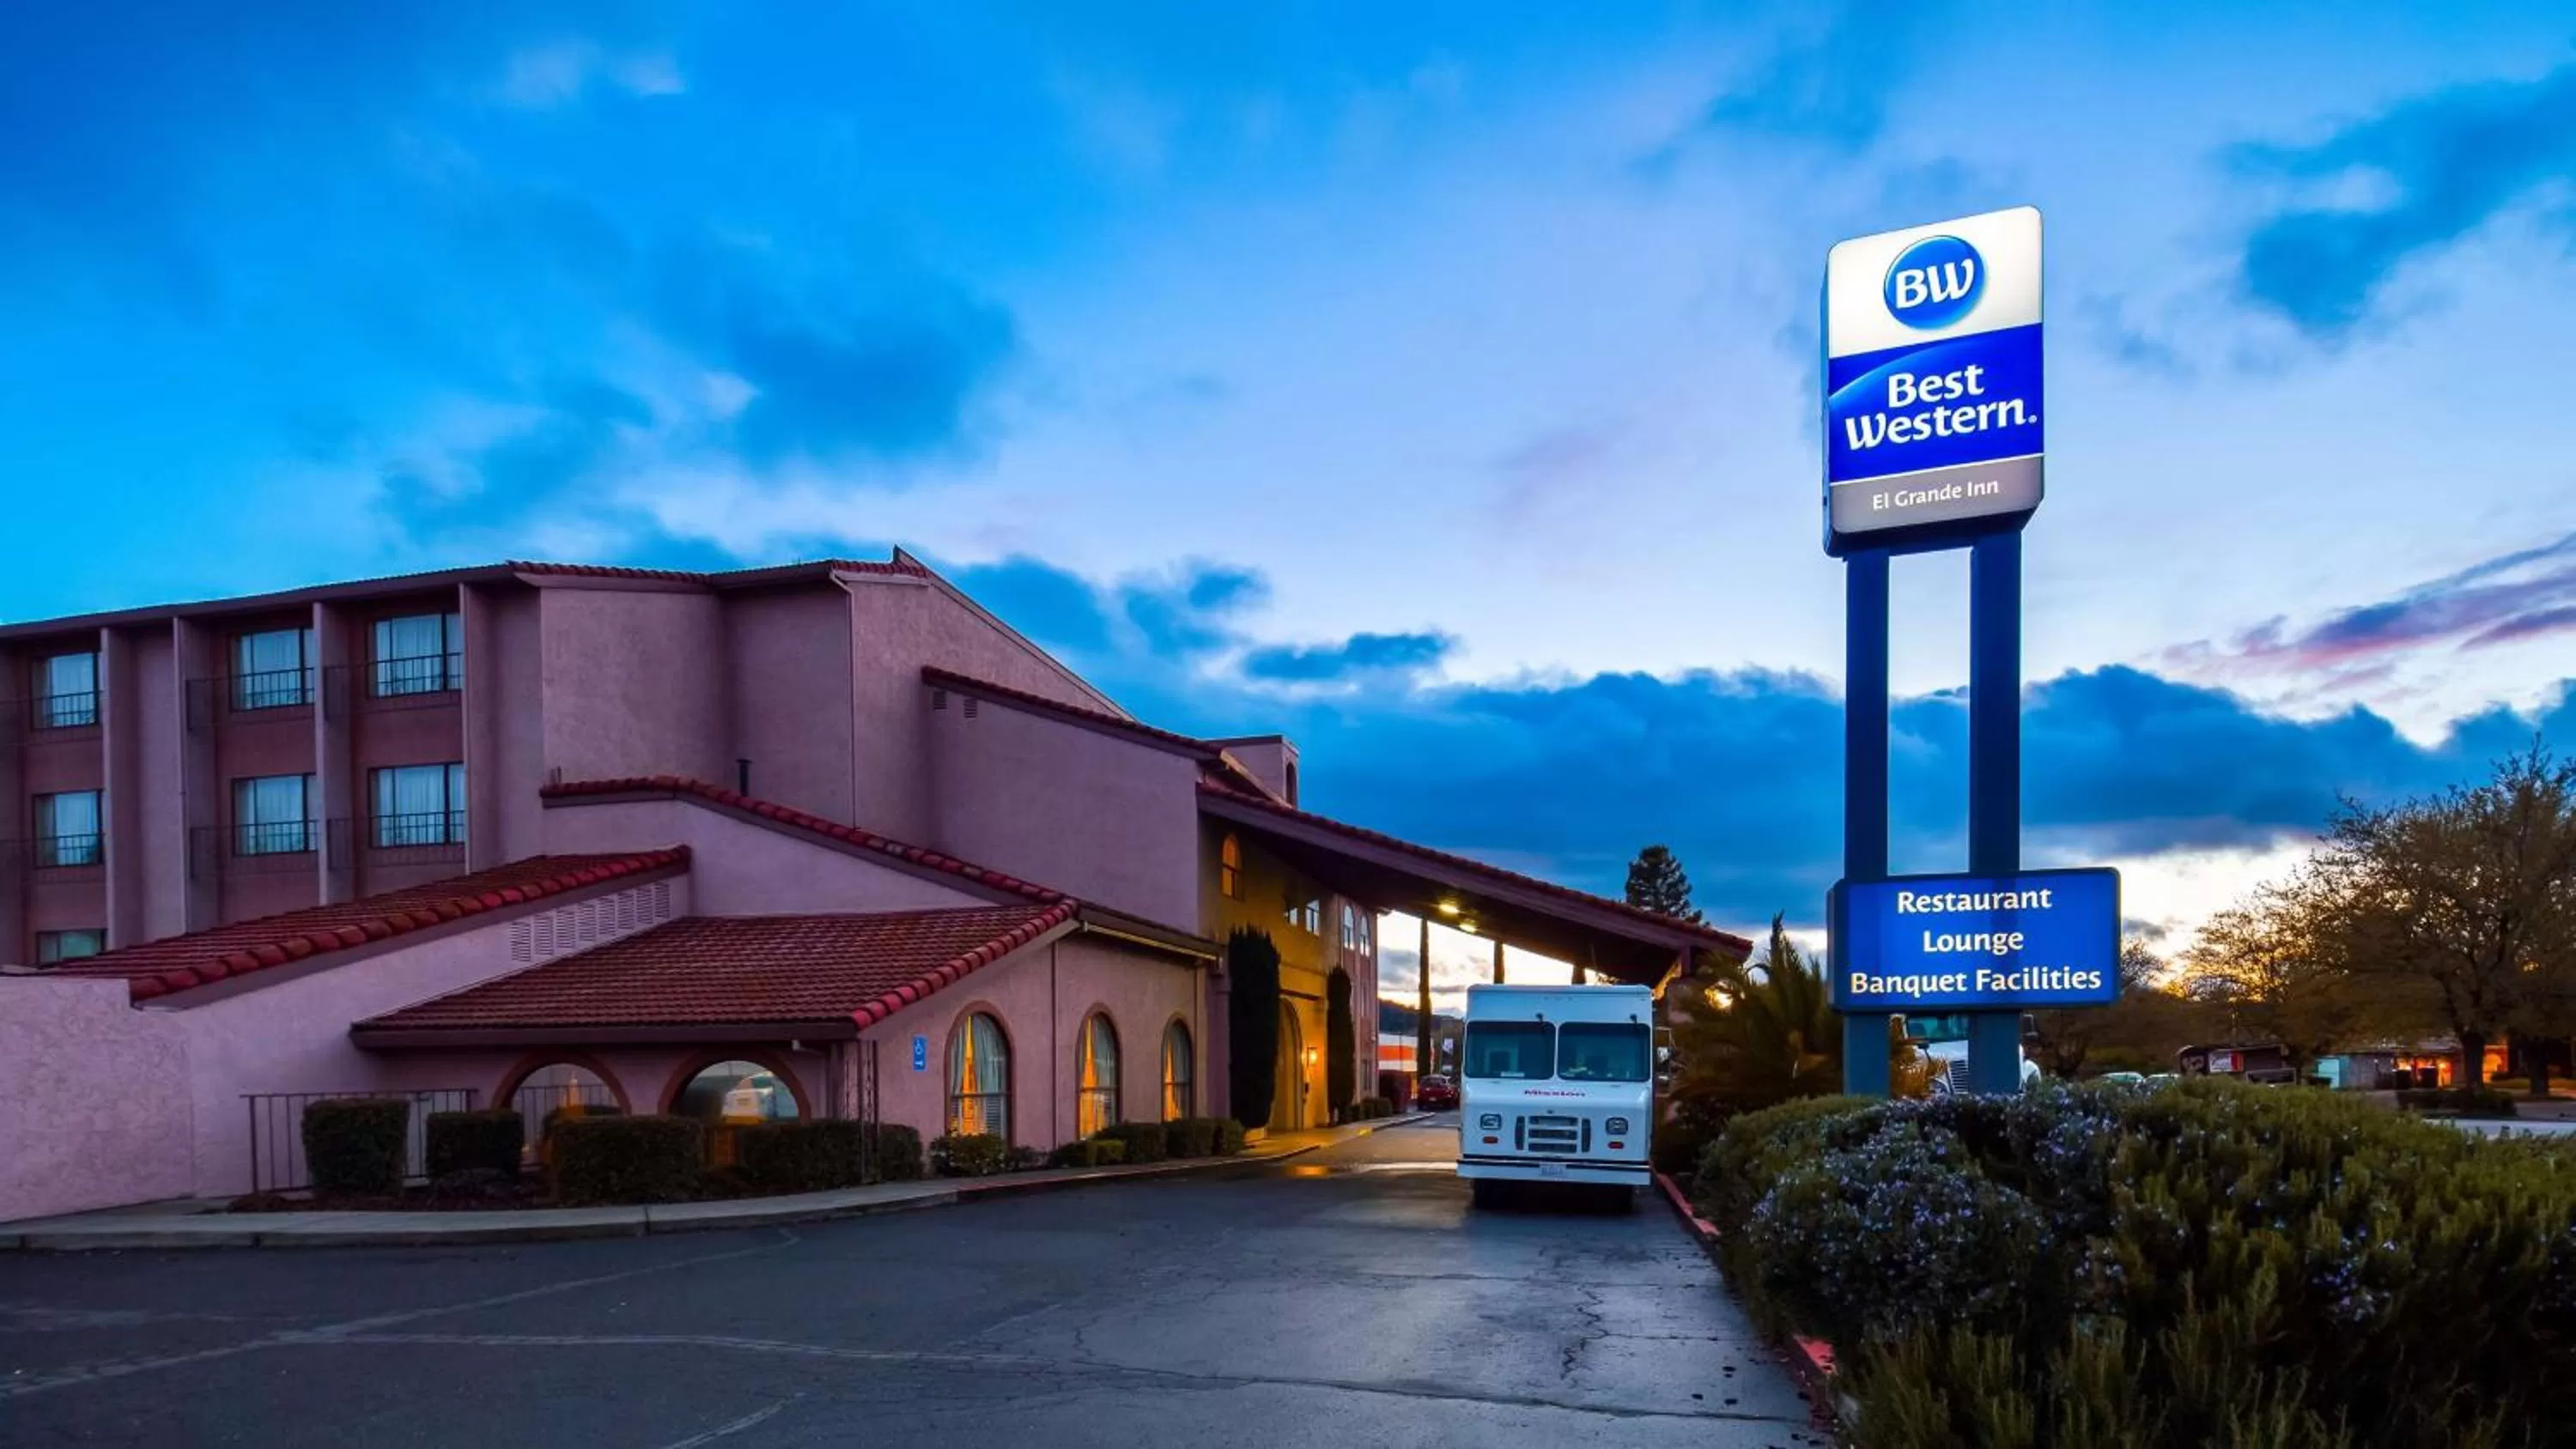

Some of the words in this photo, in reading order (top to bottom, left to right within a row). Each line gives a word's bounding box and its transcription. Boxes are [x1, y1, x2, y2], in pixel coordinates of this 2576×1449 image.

[1895, 258, 1974, 309] BW
[1888, 365, 1984, 408] Best
[1873, 493, 1890, 511] El
[1894, 483, 1962, 507] Grande
[1967, 479, 1999, 497] Inn
[1898, 888, 2052, 913] Restaurant
[1923, 931, 2024, 955] Lounge
[1850, 972, 1967, 997] Banquet
[1976, 966, 2102, 991] Facilities
